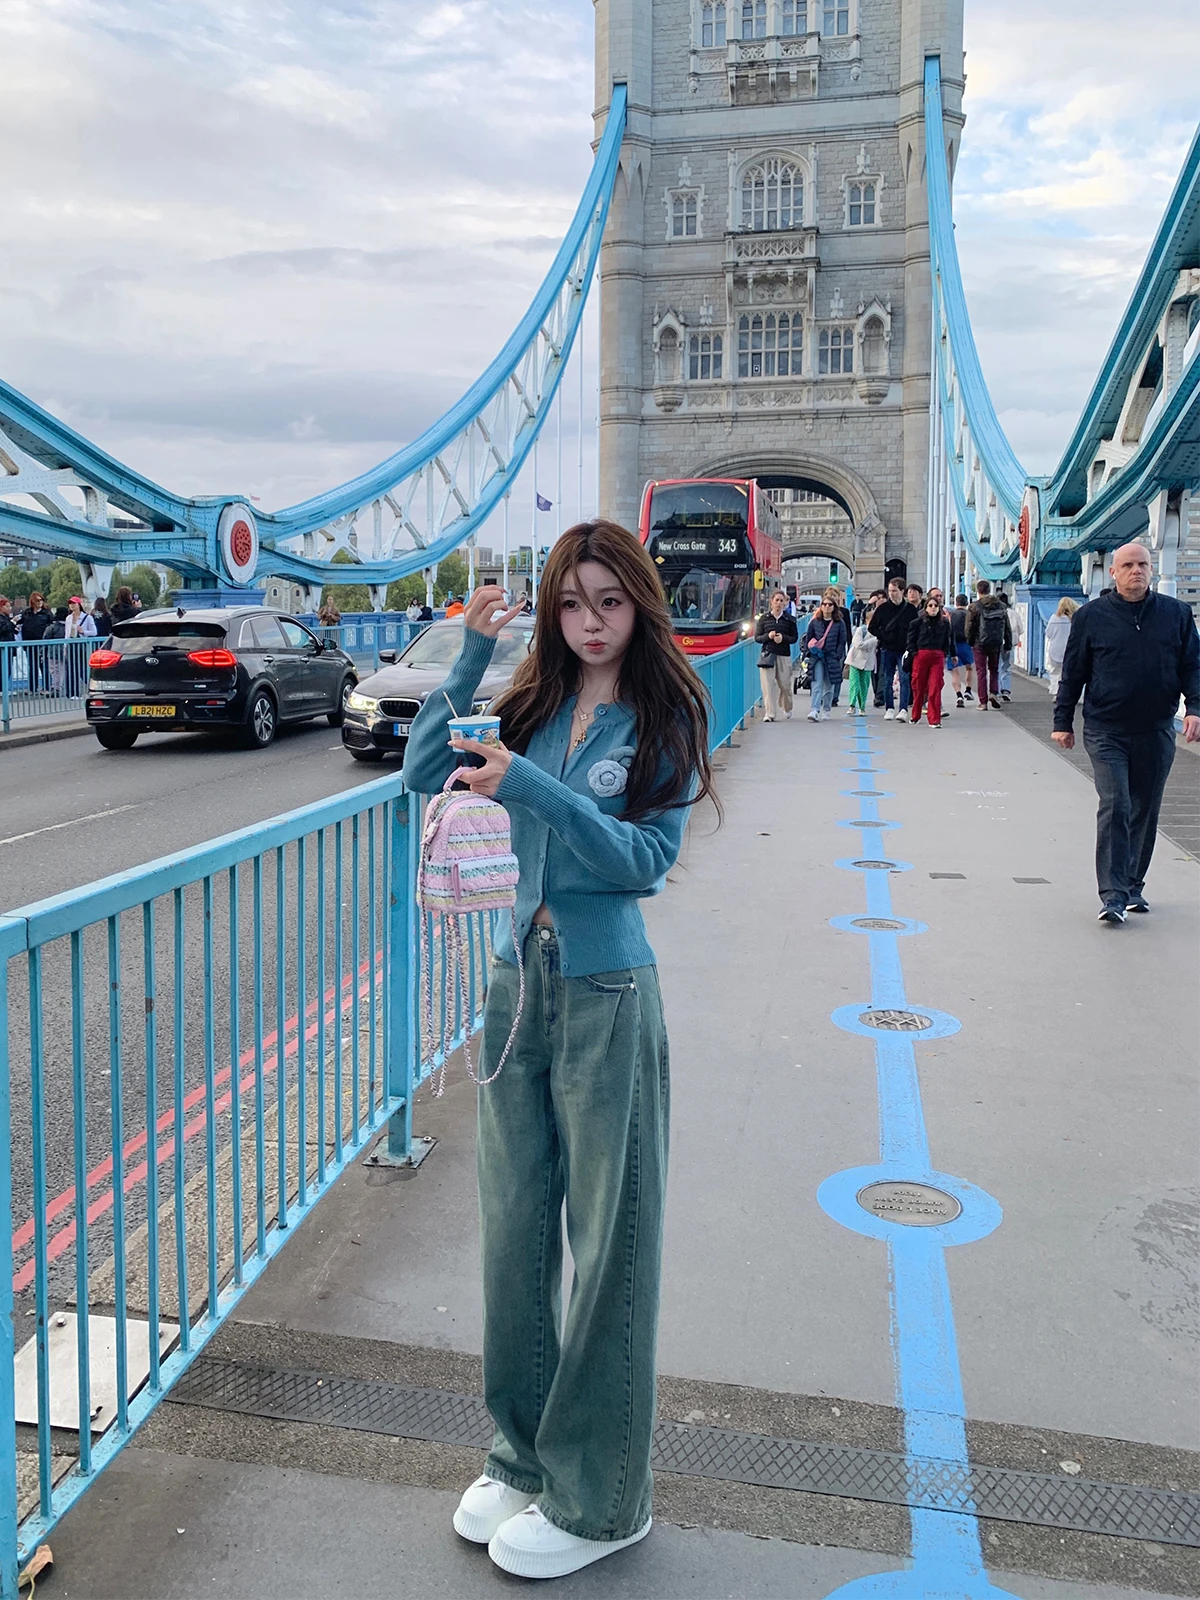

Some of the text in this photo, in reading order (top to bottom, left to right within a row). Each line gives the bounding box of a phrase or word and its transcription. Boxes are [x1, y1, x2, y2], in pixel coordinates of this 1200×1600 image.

[658, 538, 737, 553] New Cross Gate 343
[135, 706, 173, 715] LB21 HZC
